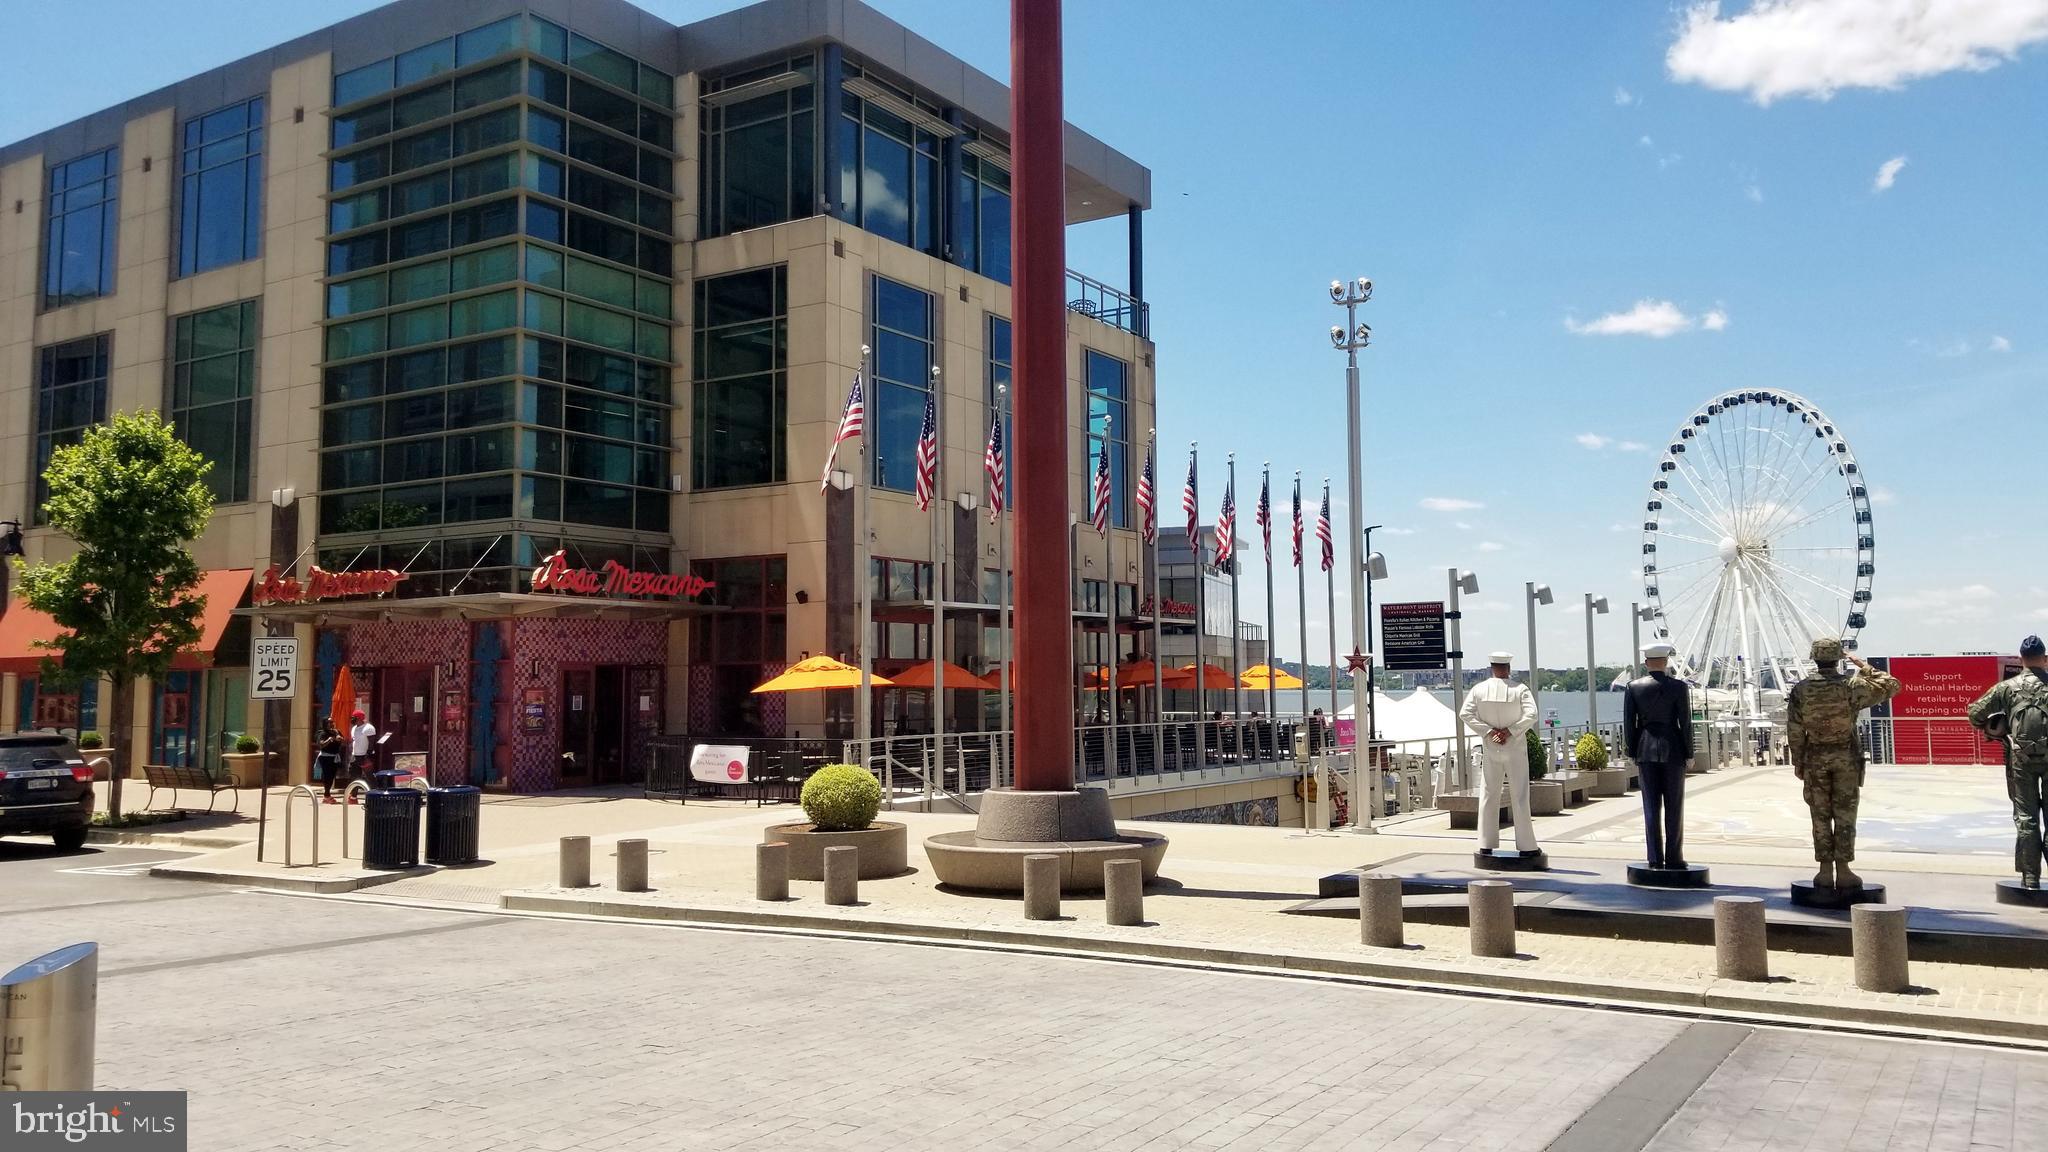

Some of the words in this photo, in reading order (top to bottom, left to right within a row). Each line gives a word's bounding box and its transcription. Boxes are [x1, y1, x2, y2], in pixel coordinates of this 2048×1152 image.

[530, 550, 600, 593] Rosa
[602, 560, 716, 596] Mexicano
[257, 645, 295, 654] SPEED
[260, 657, 291, 667] LIMIT
[257, 669, 291, 691] 25
[1923, 672, 1962, 682] Support
[1905, 684, 1945, 692] National
[1948, 684, 1982, 692] Harbor
[1959, 696, 1971, 705] by
[1905, 706, 1950, 716] shopping
[1952, 706, 1968, 714] onl
